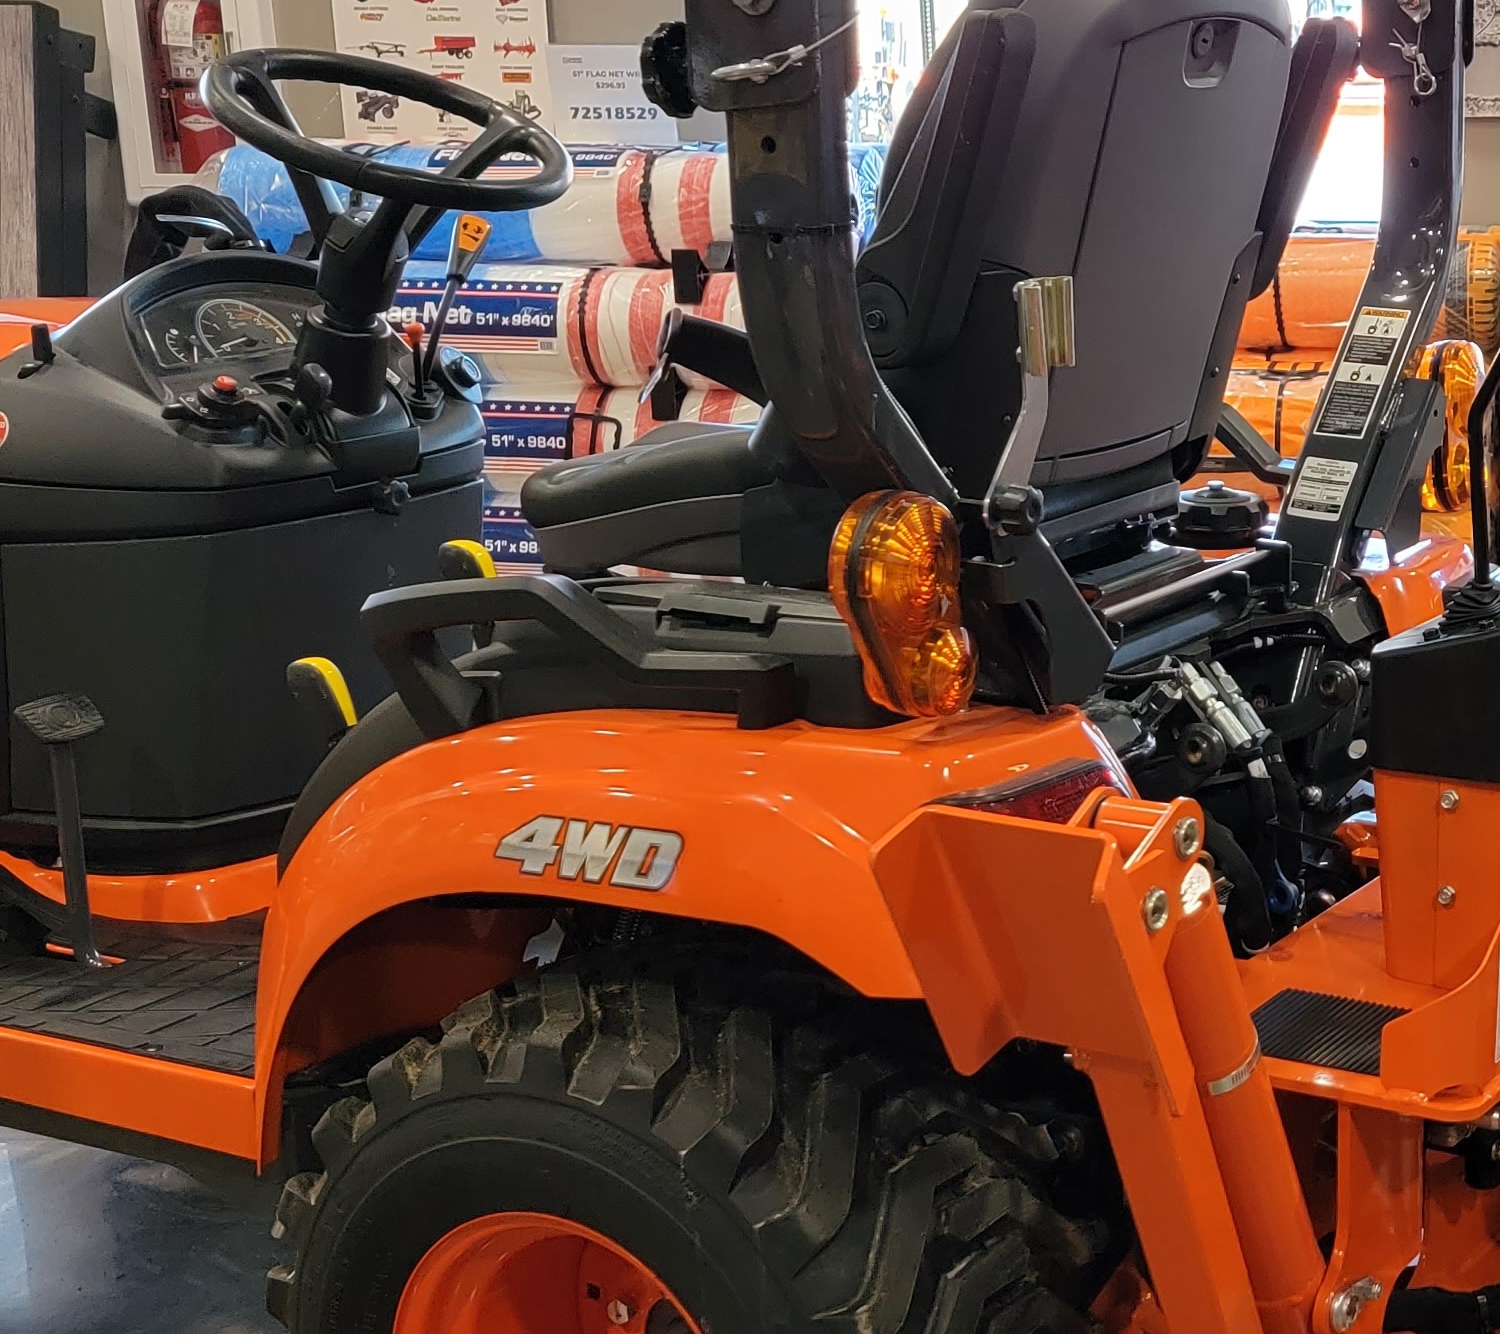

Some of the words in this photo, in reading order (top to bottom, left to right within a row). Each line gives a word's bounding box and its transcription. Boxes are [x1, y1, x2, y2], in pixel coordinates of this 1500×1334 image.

[569, 106, 658, 120] 72518529
[422, 301, 471, 324] Net
[476, 313, 499, 326] 51"
[501, 317, 511, 326] x
[492, 435, 515, 448] 51"
[517, 437, 525, 447] x
[484, 539, 508, 553] 51"
[509, 542, 517, 553] x
[519, 541, 540, 554] 98
[494, 814, 685, 892] 4WD
